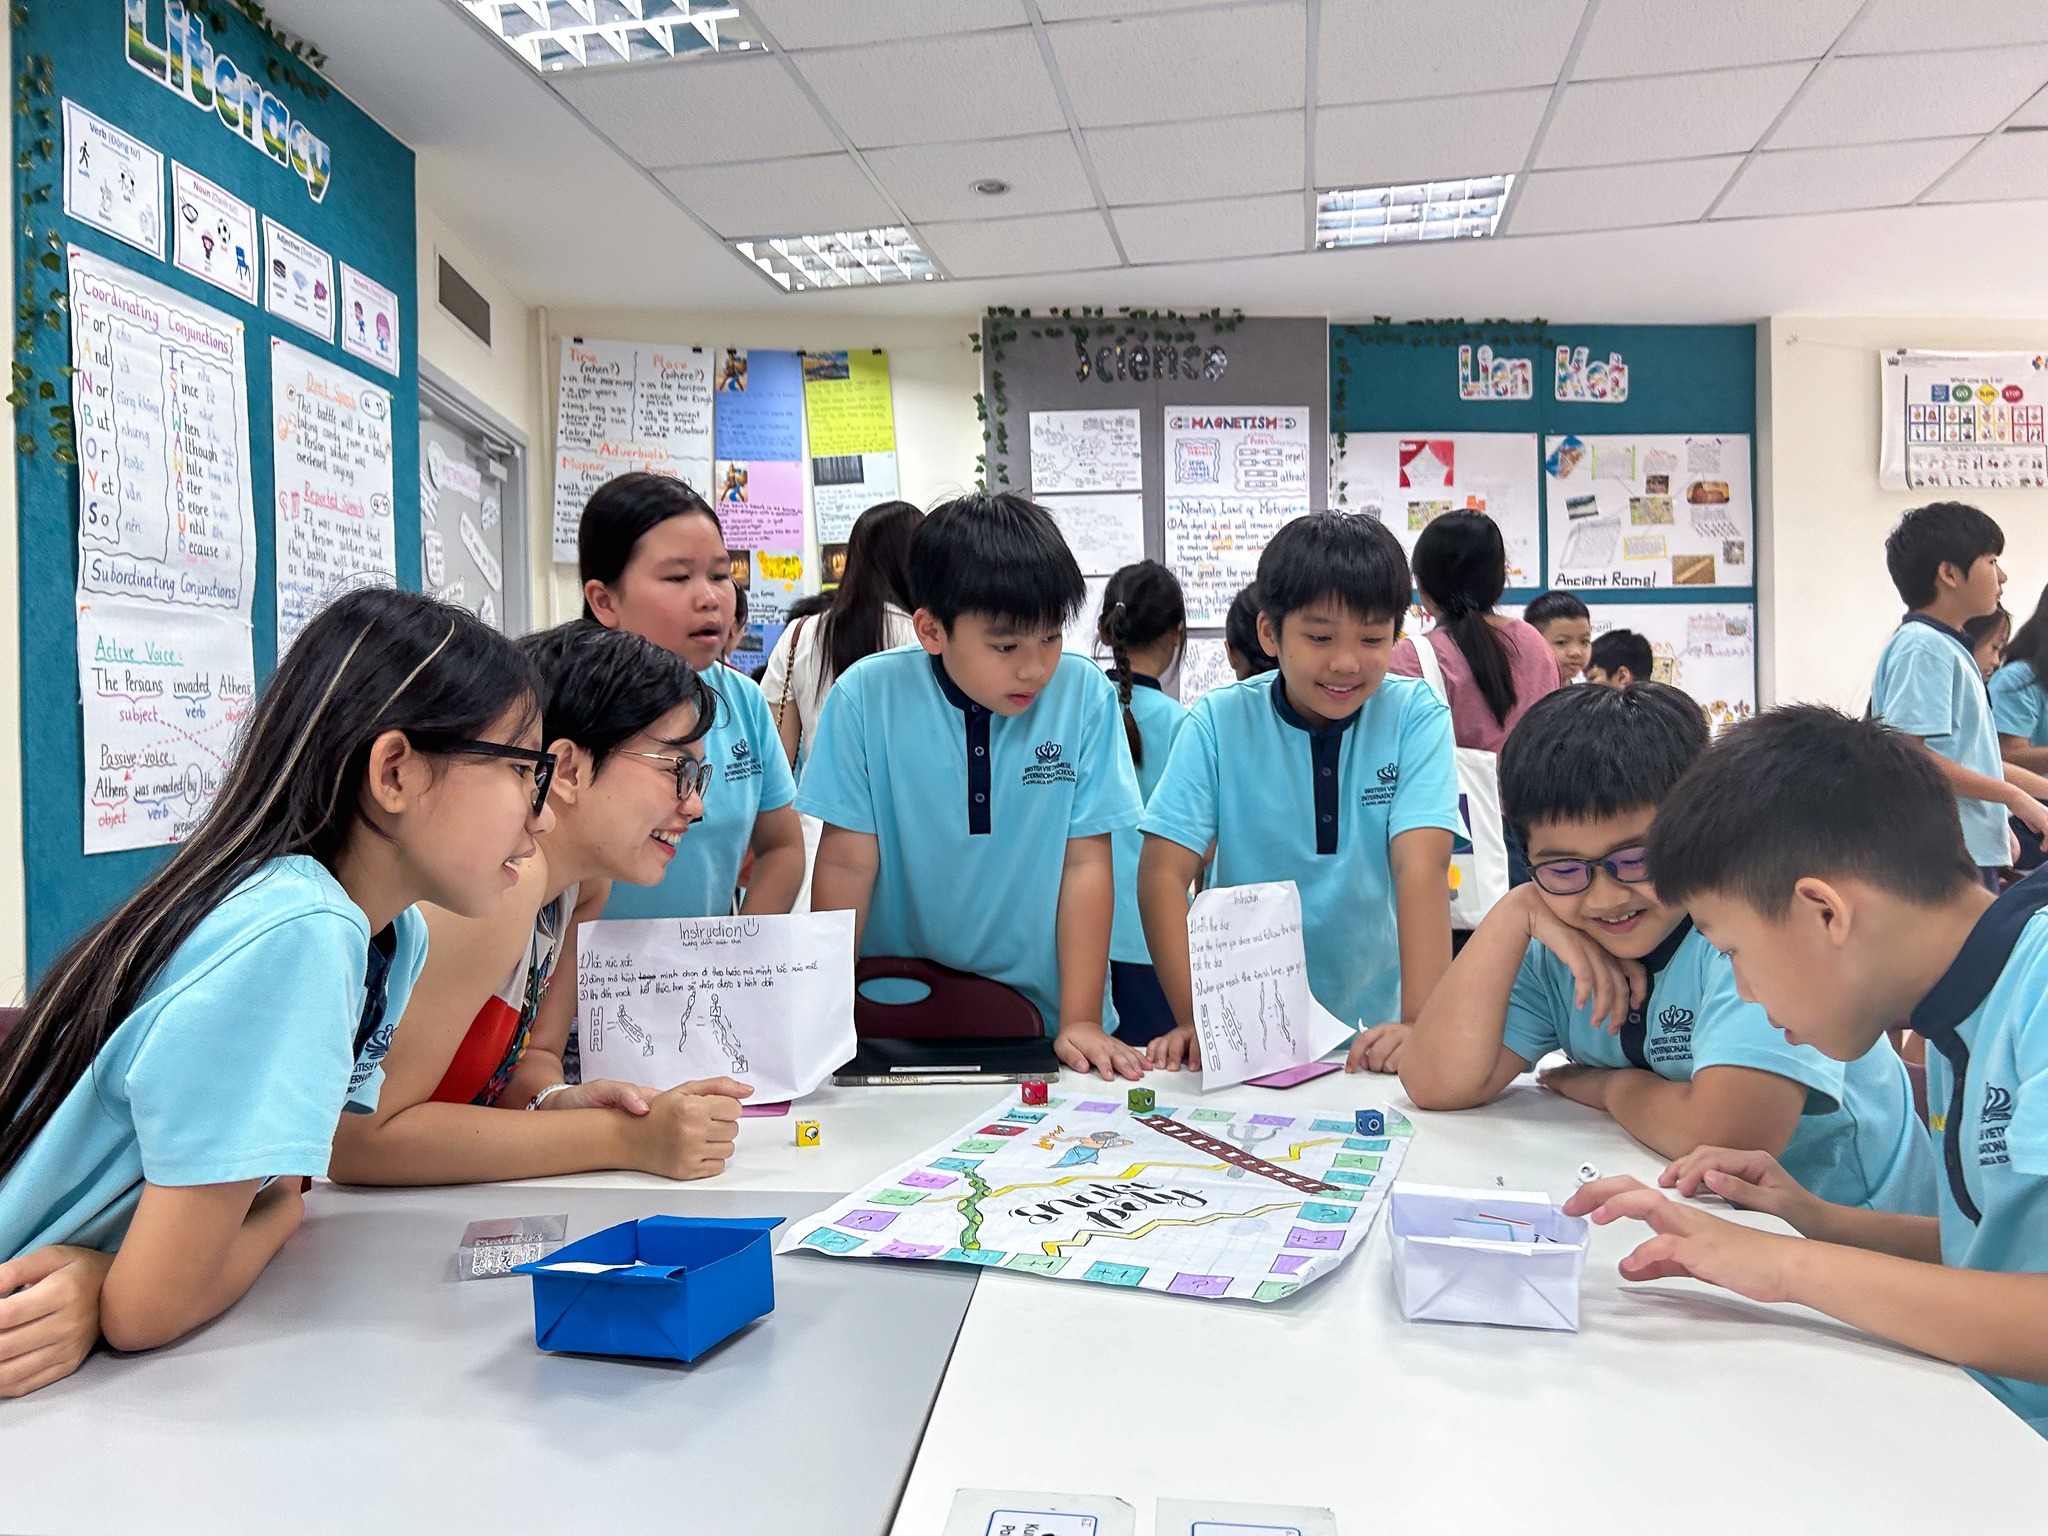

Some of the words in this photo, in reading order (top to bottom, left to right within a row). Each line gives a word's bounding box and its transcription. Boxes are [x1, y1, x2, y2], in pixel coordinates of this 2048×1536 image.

[125, 0, 330, 203] Literacy
[89, 121, 107, 140] Verb
[193, 181, 211, 198] Noun
[83, 275, 159, 332] Coordinating
[168, 310, 229, 353] Conjunctions
[1075, 335, 1228, 383] Science
[1192, 416, 1277, 430] MAGNETISM
[91, 558, 175, 600] Subordinating
[180, 571, 237, 601] Conjunctions
[1555, 571, 1607, 587] Ancient
[95, 635, 135, 660] Active
[91, 667, 119, 692] The
[124, 669, 164, 693] Persians
[173, 672, 210, 693] invaded
[218, 674, 251, 696] Athens
[119, 705, 160, 728] subject
[185, 706, 206, 719] verb
[100, 744, 137, 767] Passive
[94, 776, 128, 799] Athens
[135, 784, 149, 797] was
[153, 775, 183, 796] invaded
[98, 811, 127, 829] object
[148, 806, 168, 821] verb
